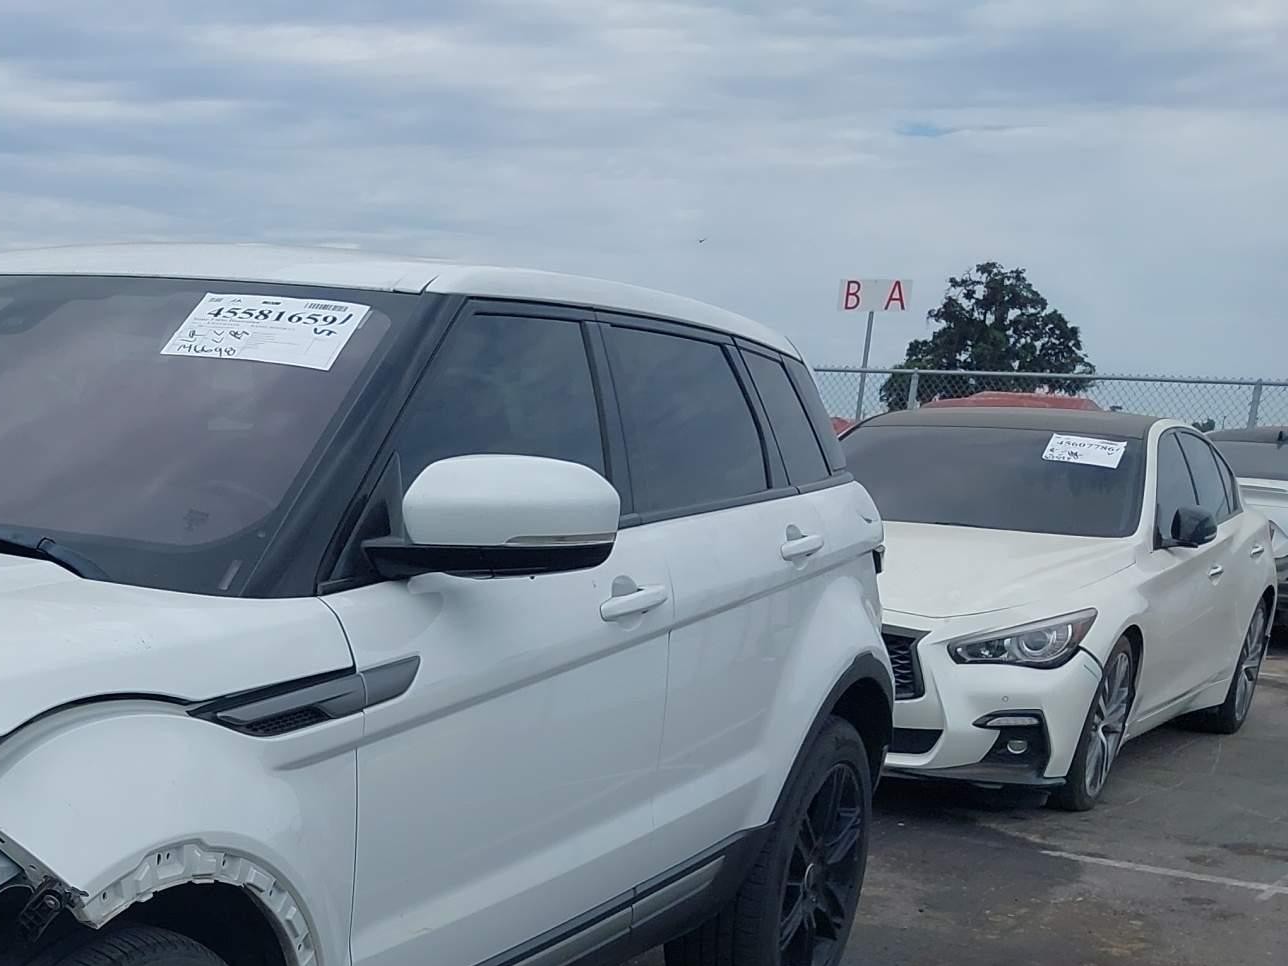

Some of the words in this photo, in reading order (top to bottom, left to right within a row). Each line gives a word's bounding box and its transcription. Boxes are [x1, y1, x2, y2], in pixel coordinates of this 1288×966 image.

[843, 279, 862, 311] B
[883, 279, 906, 311] A
[207, 307, 338, 326] 45581659
